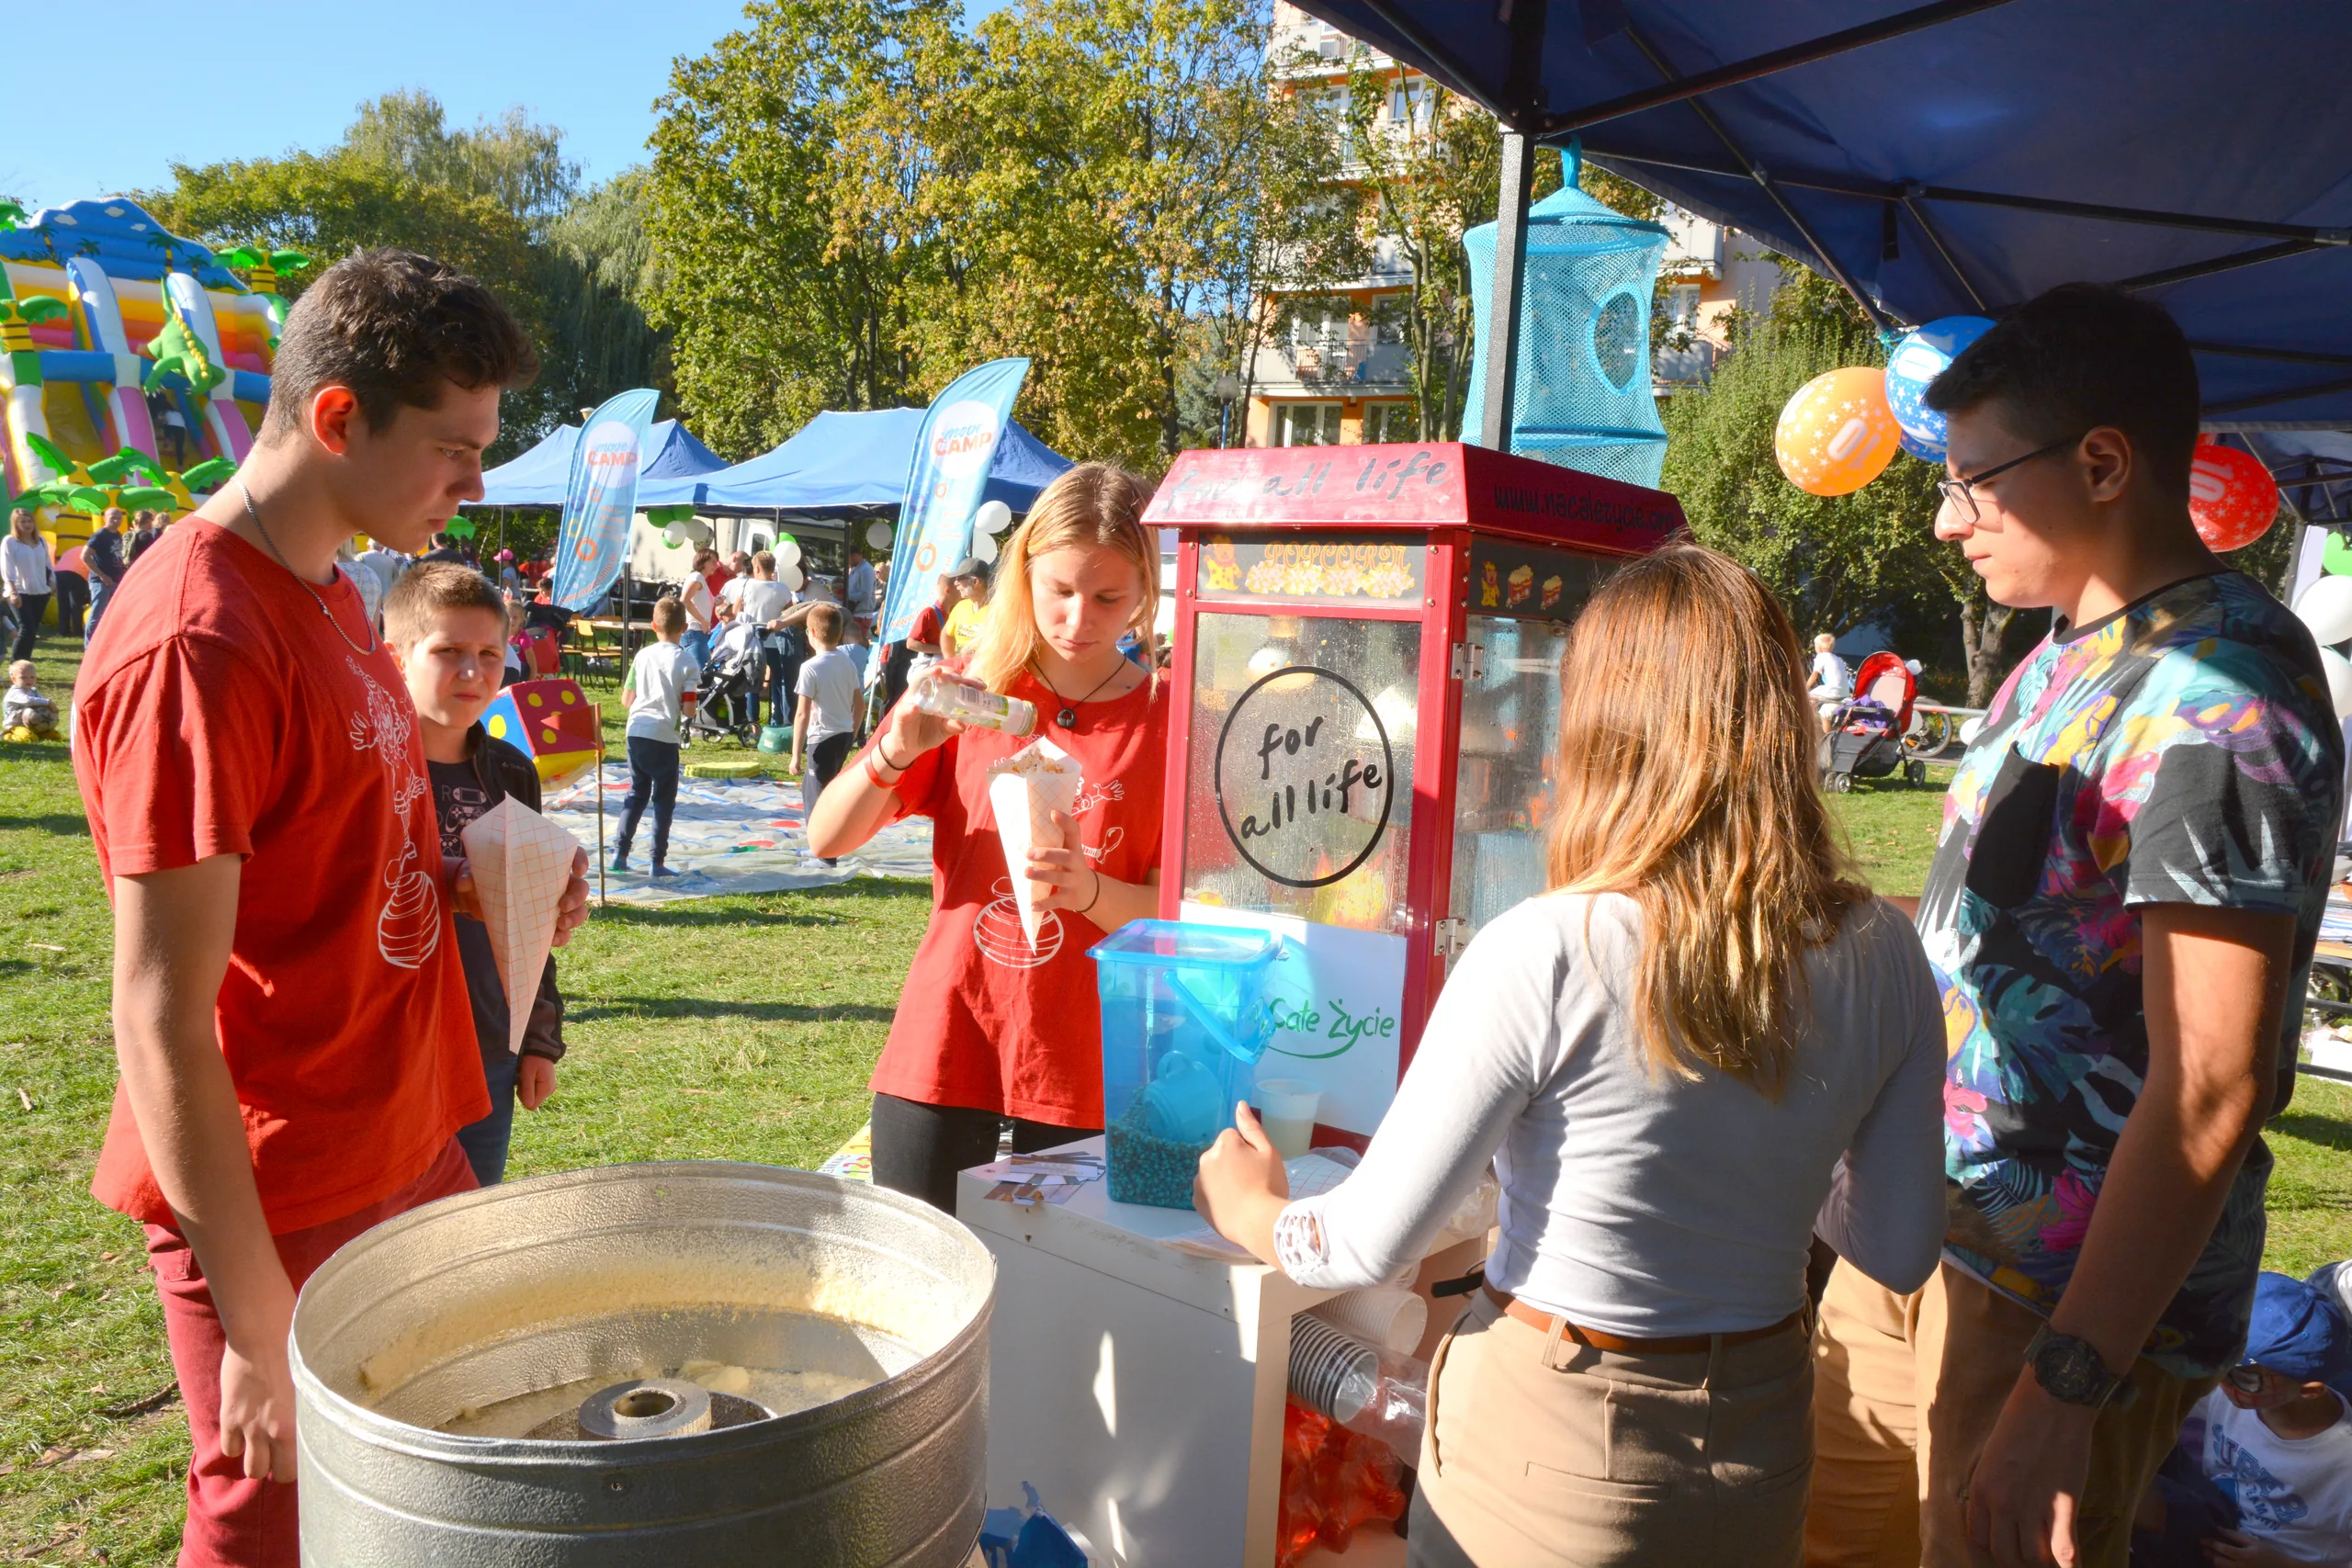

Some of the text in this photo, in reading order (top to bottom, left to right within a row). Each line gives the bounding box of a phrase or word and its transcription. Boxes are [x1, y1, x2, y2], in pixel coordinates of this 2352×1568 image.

[588, 450, 638, 467] CAMP
[933, 432, 992, 456] CAMP
[1163, 451, 1448, 513] for all life
[1264, 540, 1412, 571] POPCORN
[1258, 715, 1325, 780] for
[1240, 759, 1383, 840] all life
[1328, 998, 1395, 1043] Życie
